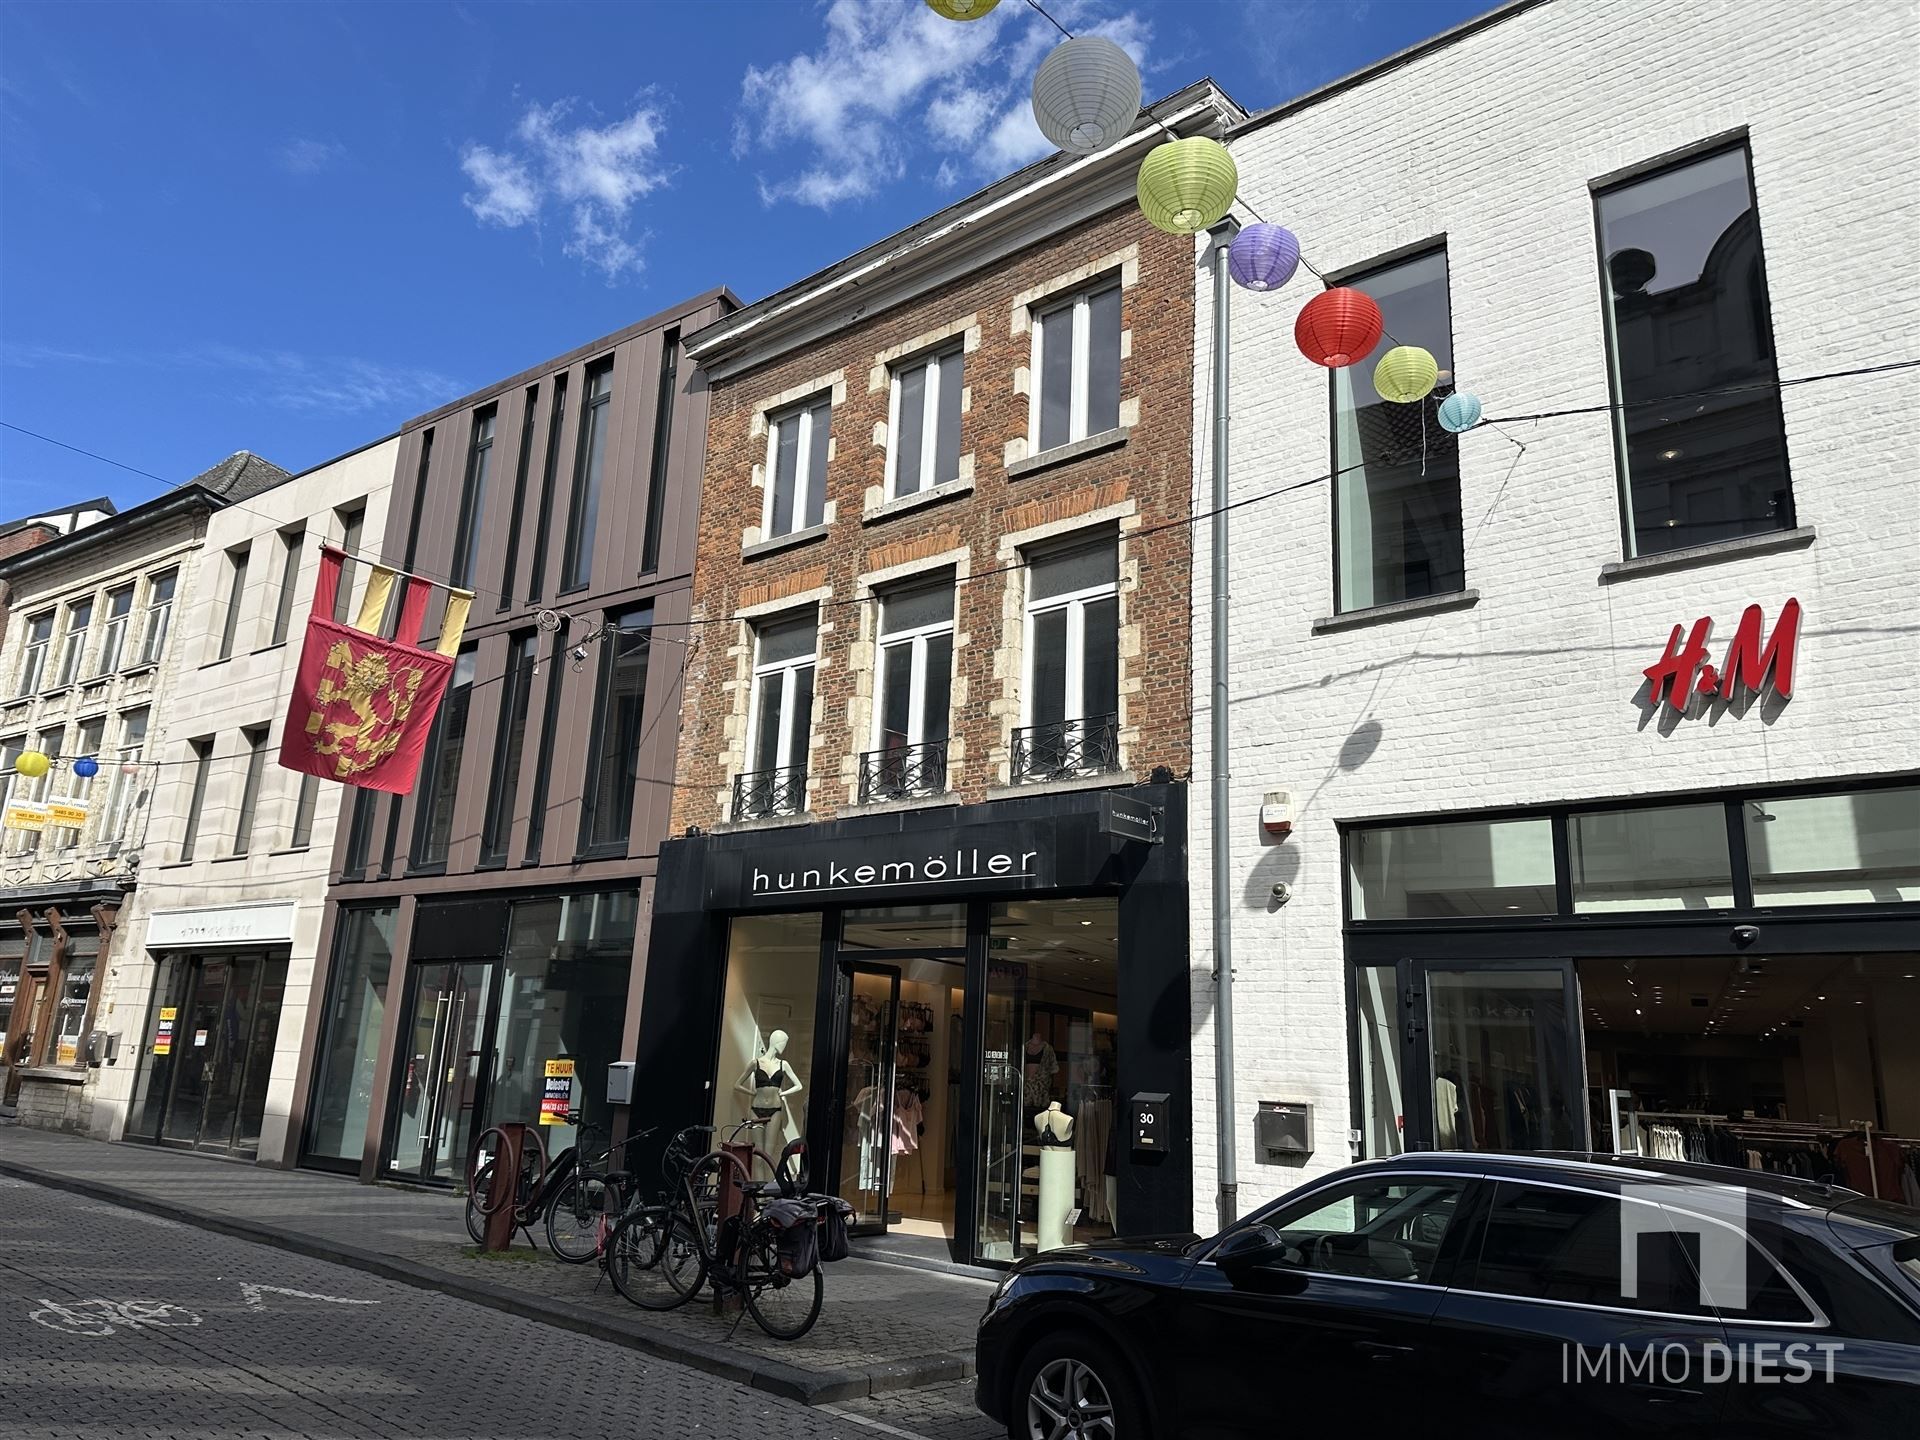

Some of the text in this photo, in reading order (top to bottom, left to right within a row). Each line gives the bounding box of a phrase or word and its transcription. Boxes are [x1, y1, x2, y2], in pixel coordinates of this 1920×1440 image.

[1642, 597, 1801, 714] H&M
[1112, 810, 1149, 825] hunkemöller
[752, 848, 1037, 891] hunkemöller
[547, 1063, 573, 1074] TE HUUR
[1140, 1112, 1154, 1124] 30
